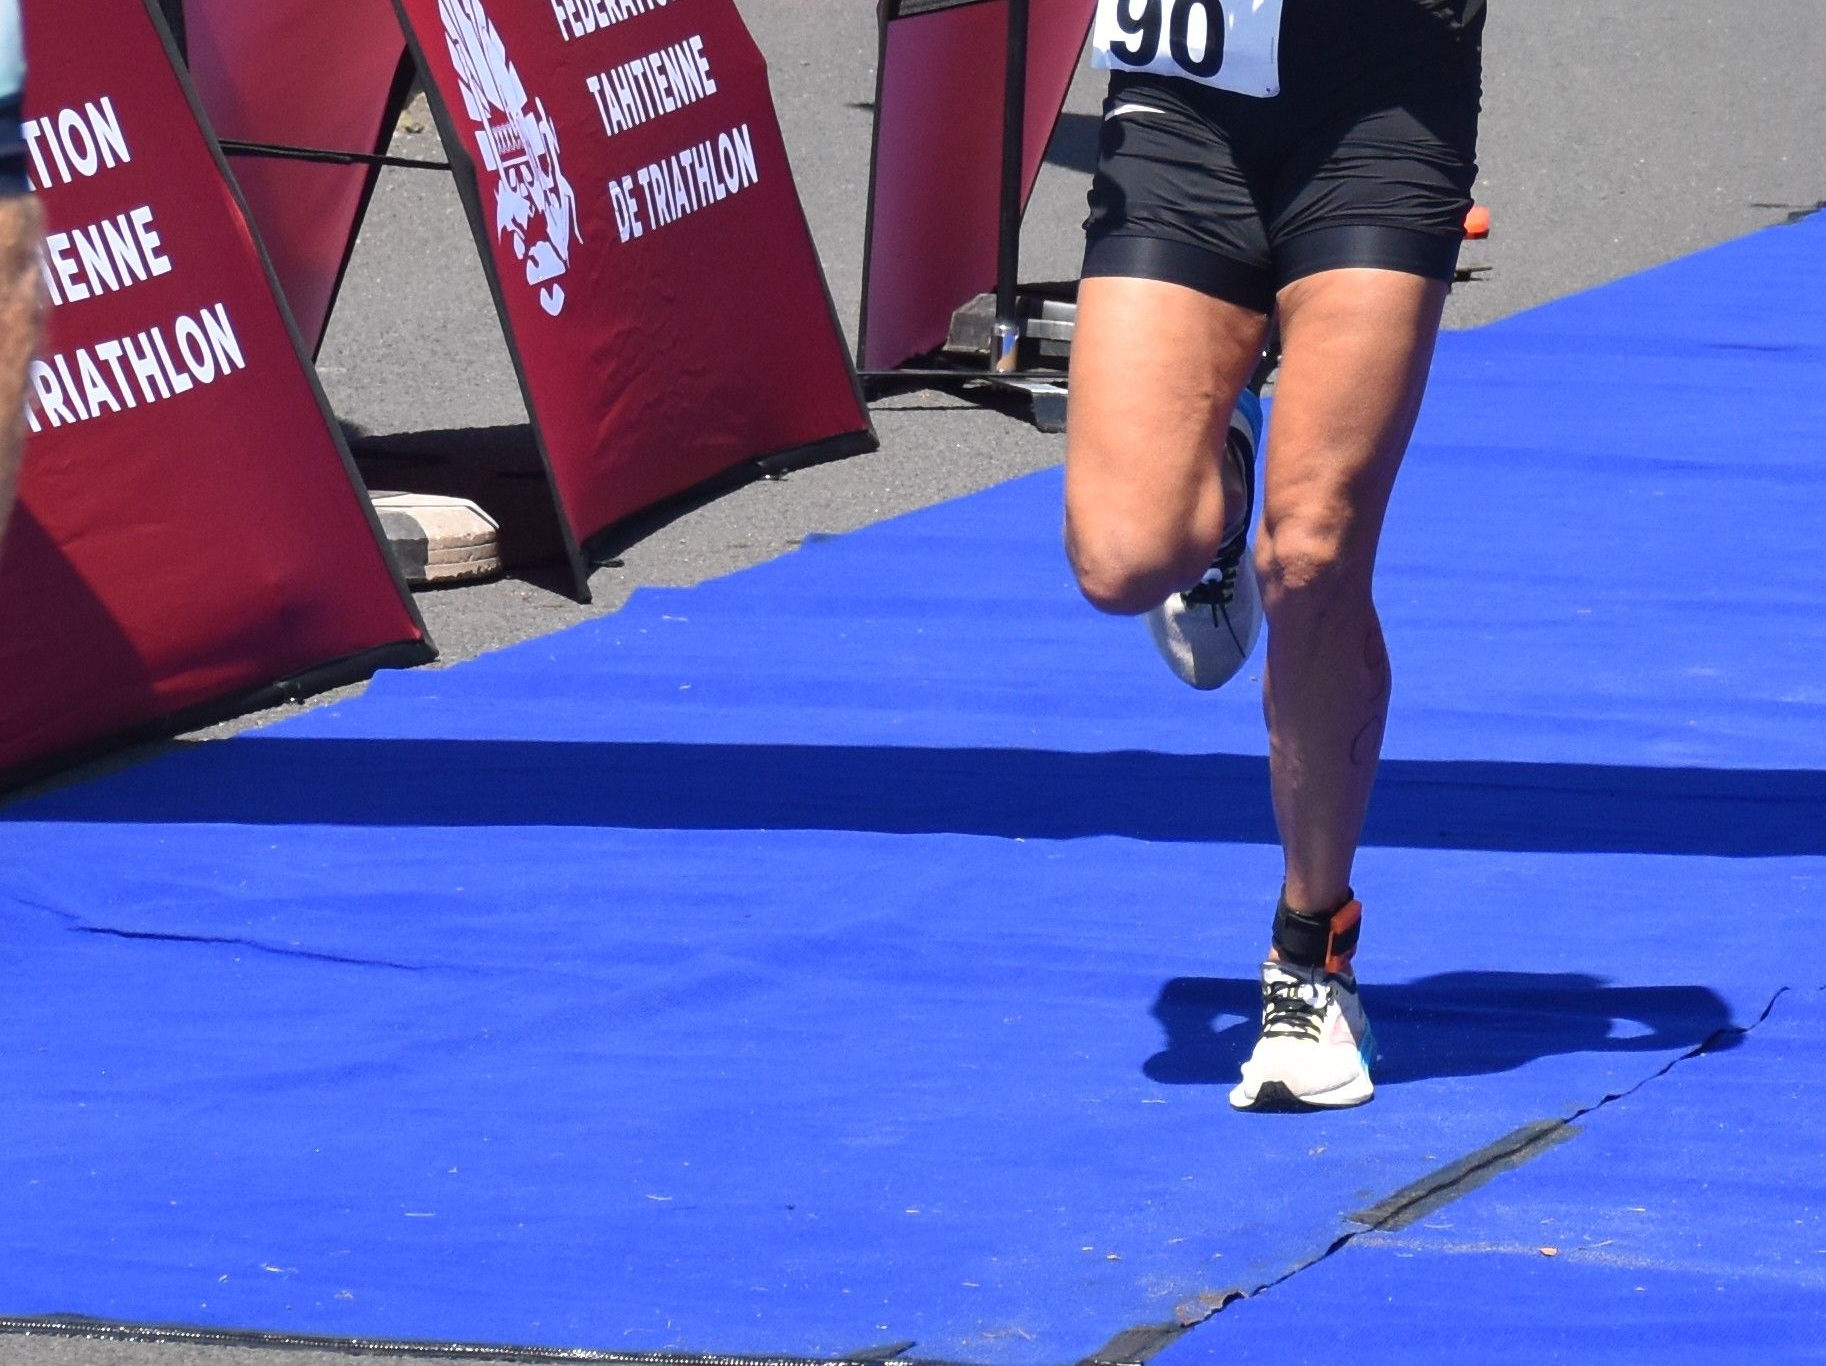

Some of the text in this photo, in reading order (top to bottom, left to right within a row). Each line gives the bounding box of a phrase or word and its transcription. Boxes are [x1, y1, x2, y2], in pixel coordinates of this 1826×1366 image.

[586, 35, 717, 136] TAHITIENNE
[21, 96, 131, 191] TION
[608, 123, 759, 244] DE TRIATHLON
